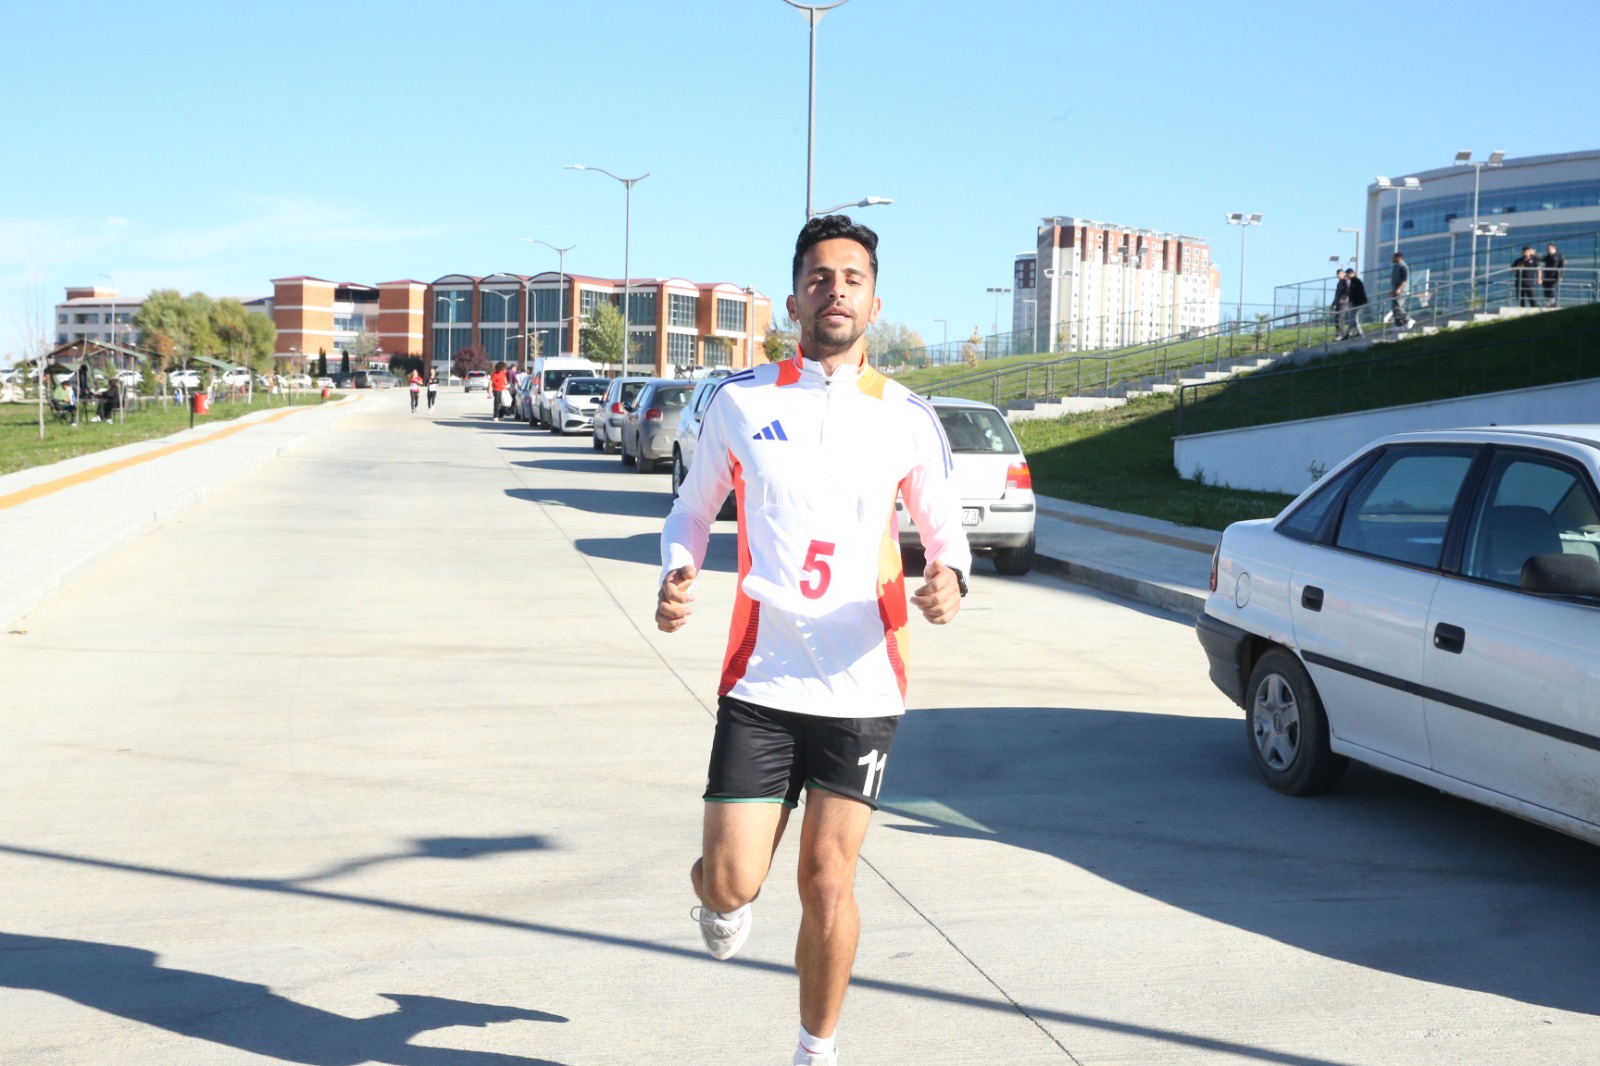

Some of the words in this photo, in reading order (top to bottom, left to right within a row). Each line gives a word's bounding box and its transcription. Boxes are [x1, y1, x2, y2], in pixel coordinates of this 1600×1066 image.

[962, 510, 977, 521] 73
[799, 539, 836, 600] 5
[857, 748, 888, 801] 11
